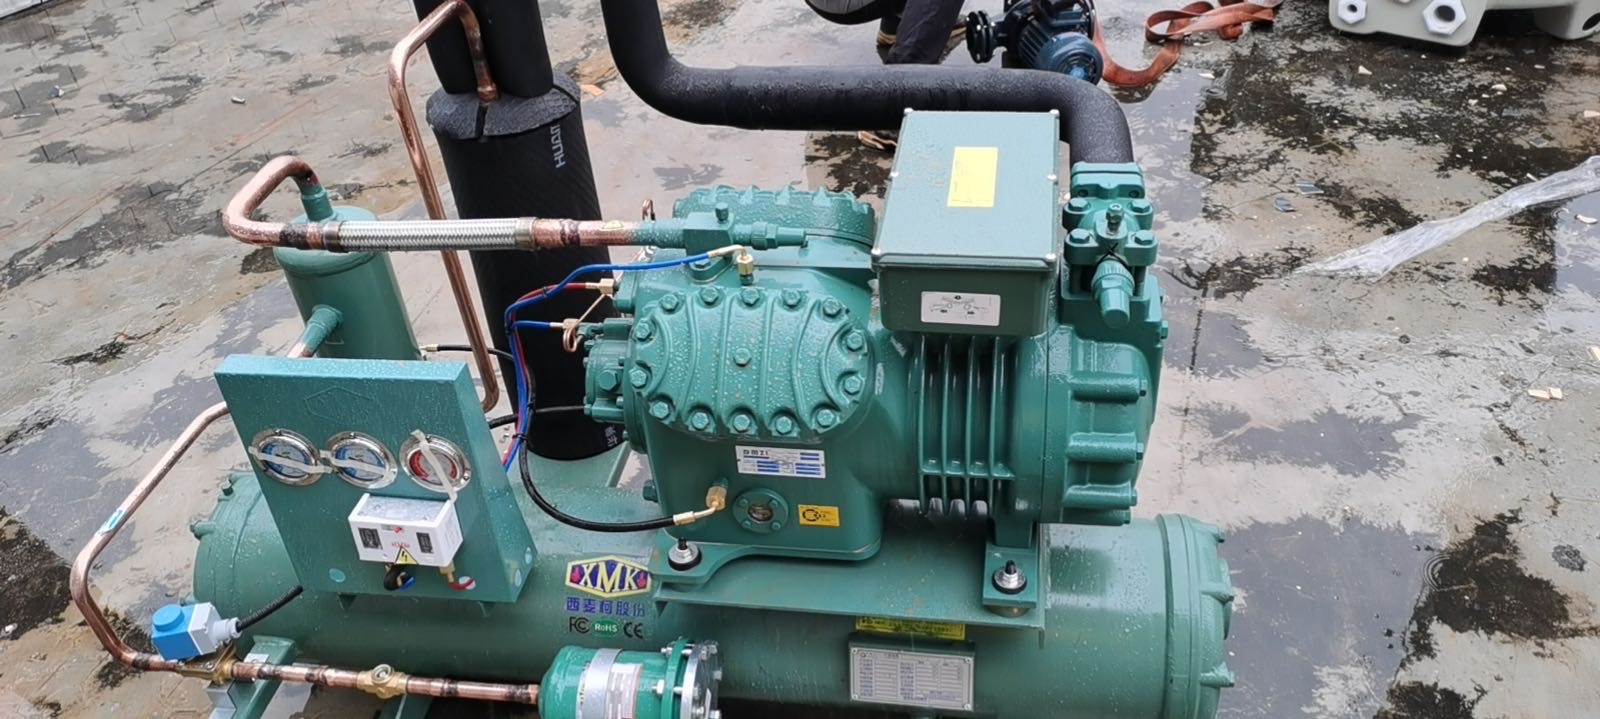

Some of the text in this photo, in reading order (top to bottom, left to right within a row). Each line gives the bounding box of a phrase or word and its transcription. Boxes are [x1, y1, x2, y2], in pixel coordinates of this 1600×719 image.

[579, 561, 640, 593] XMK
[566, 596, 645, 617] 西麦柯股份
[594, 623, 618, 632] RoHS
[623, 622, 643, 639] CE
